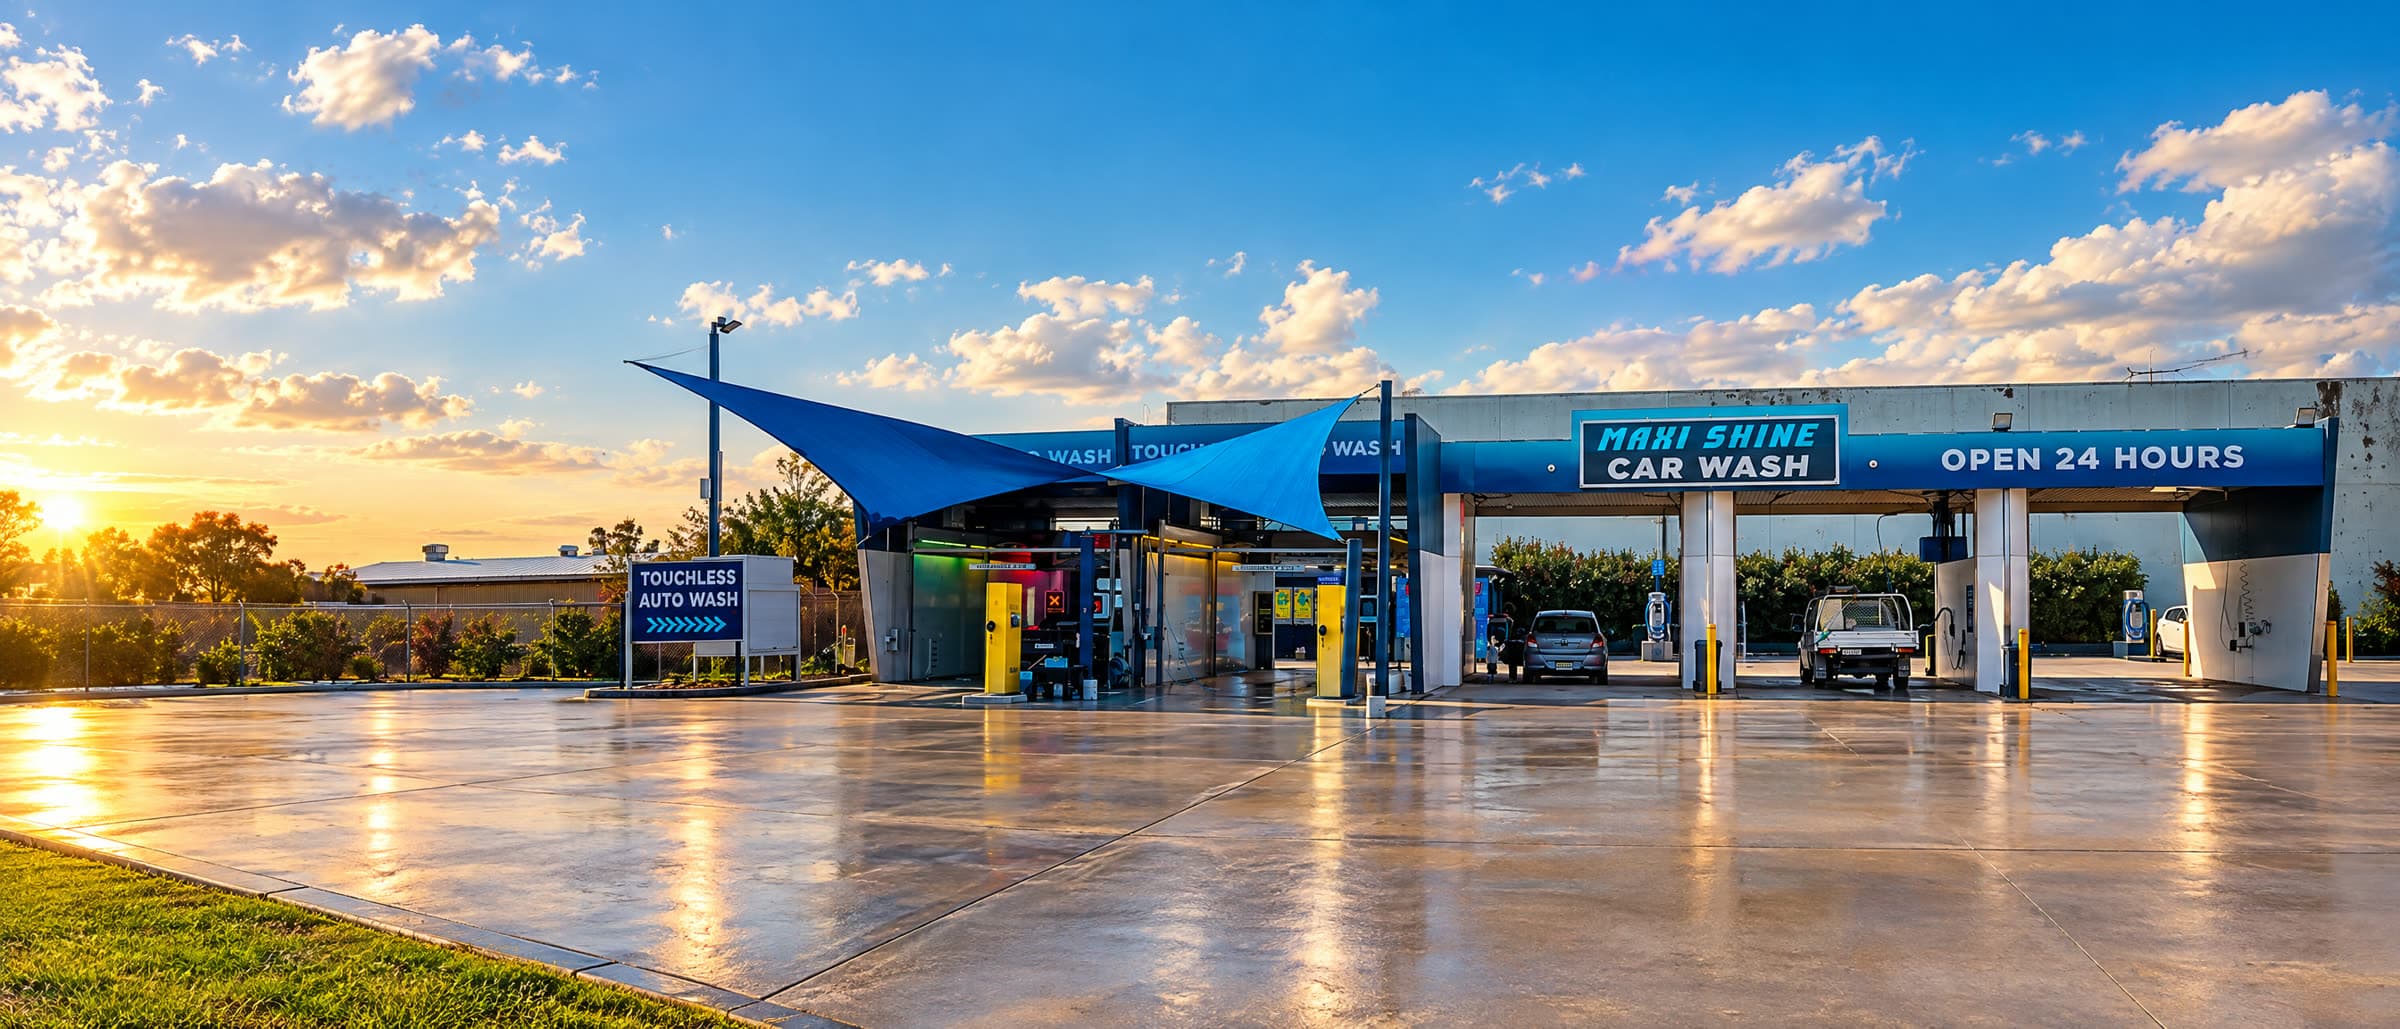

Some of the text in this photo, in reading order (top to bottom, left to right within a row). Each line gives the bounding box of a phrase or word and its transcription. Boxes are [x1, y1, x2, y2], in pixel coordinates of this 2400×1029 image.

[1598, 423, 1820, 451] MAXI SHINE
[1047, 448, 1112, 465] WASH
[1607, 454, 1809, 480] CAR WASH
[1941, 445, 2245, 472] OPEN 24 HOURS
[640, 569, 737, 586] TOUCHLESS
[639, 591, 739, 609] AUTO WASH
